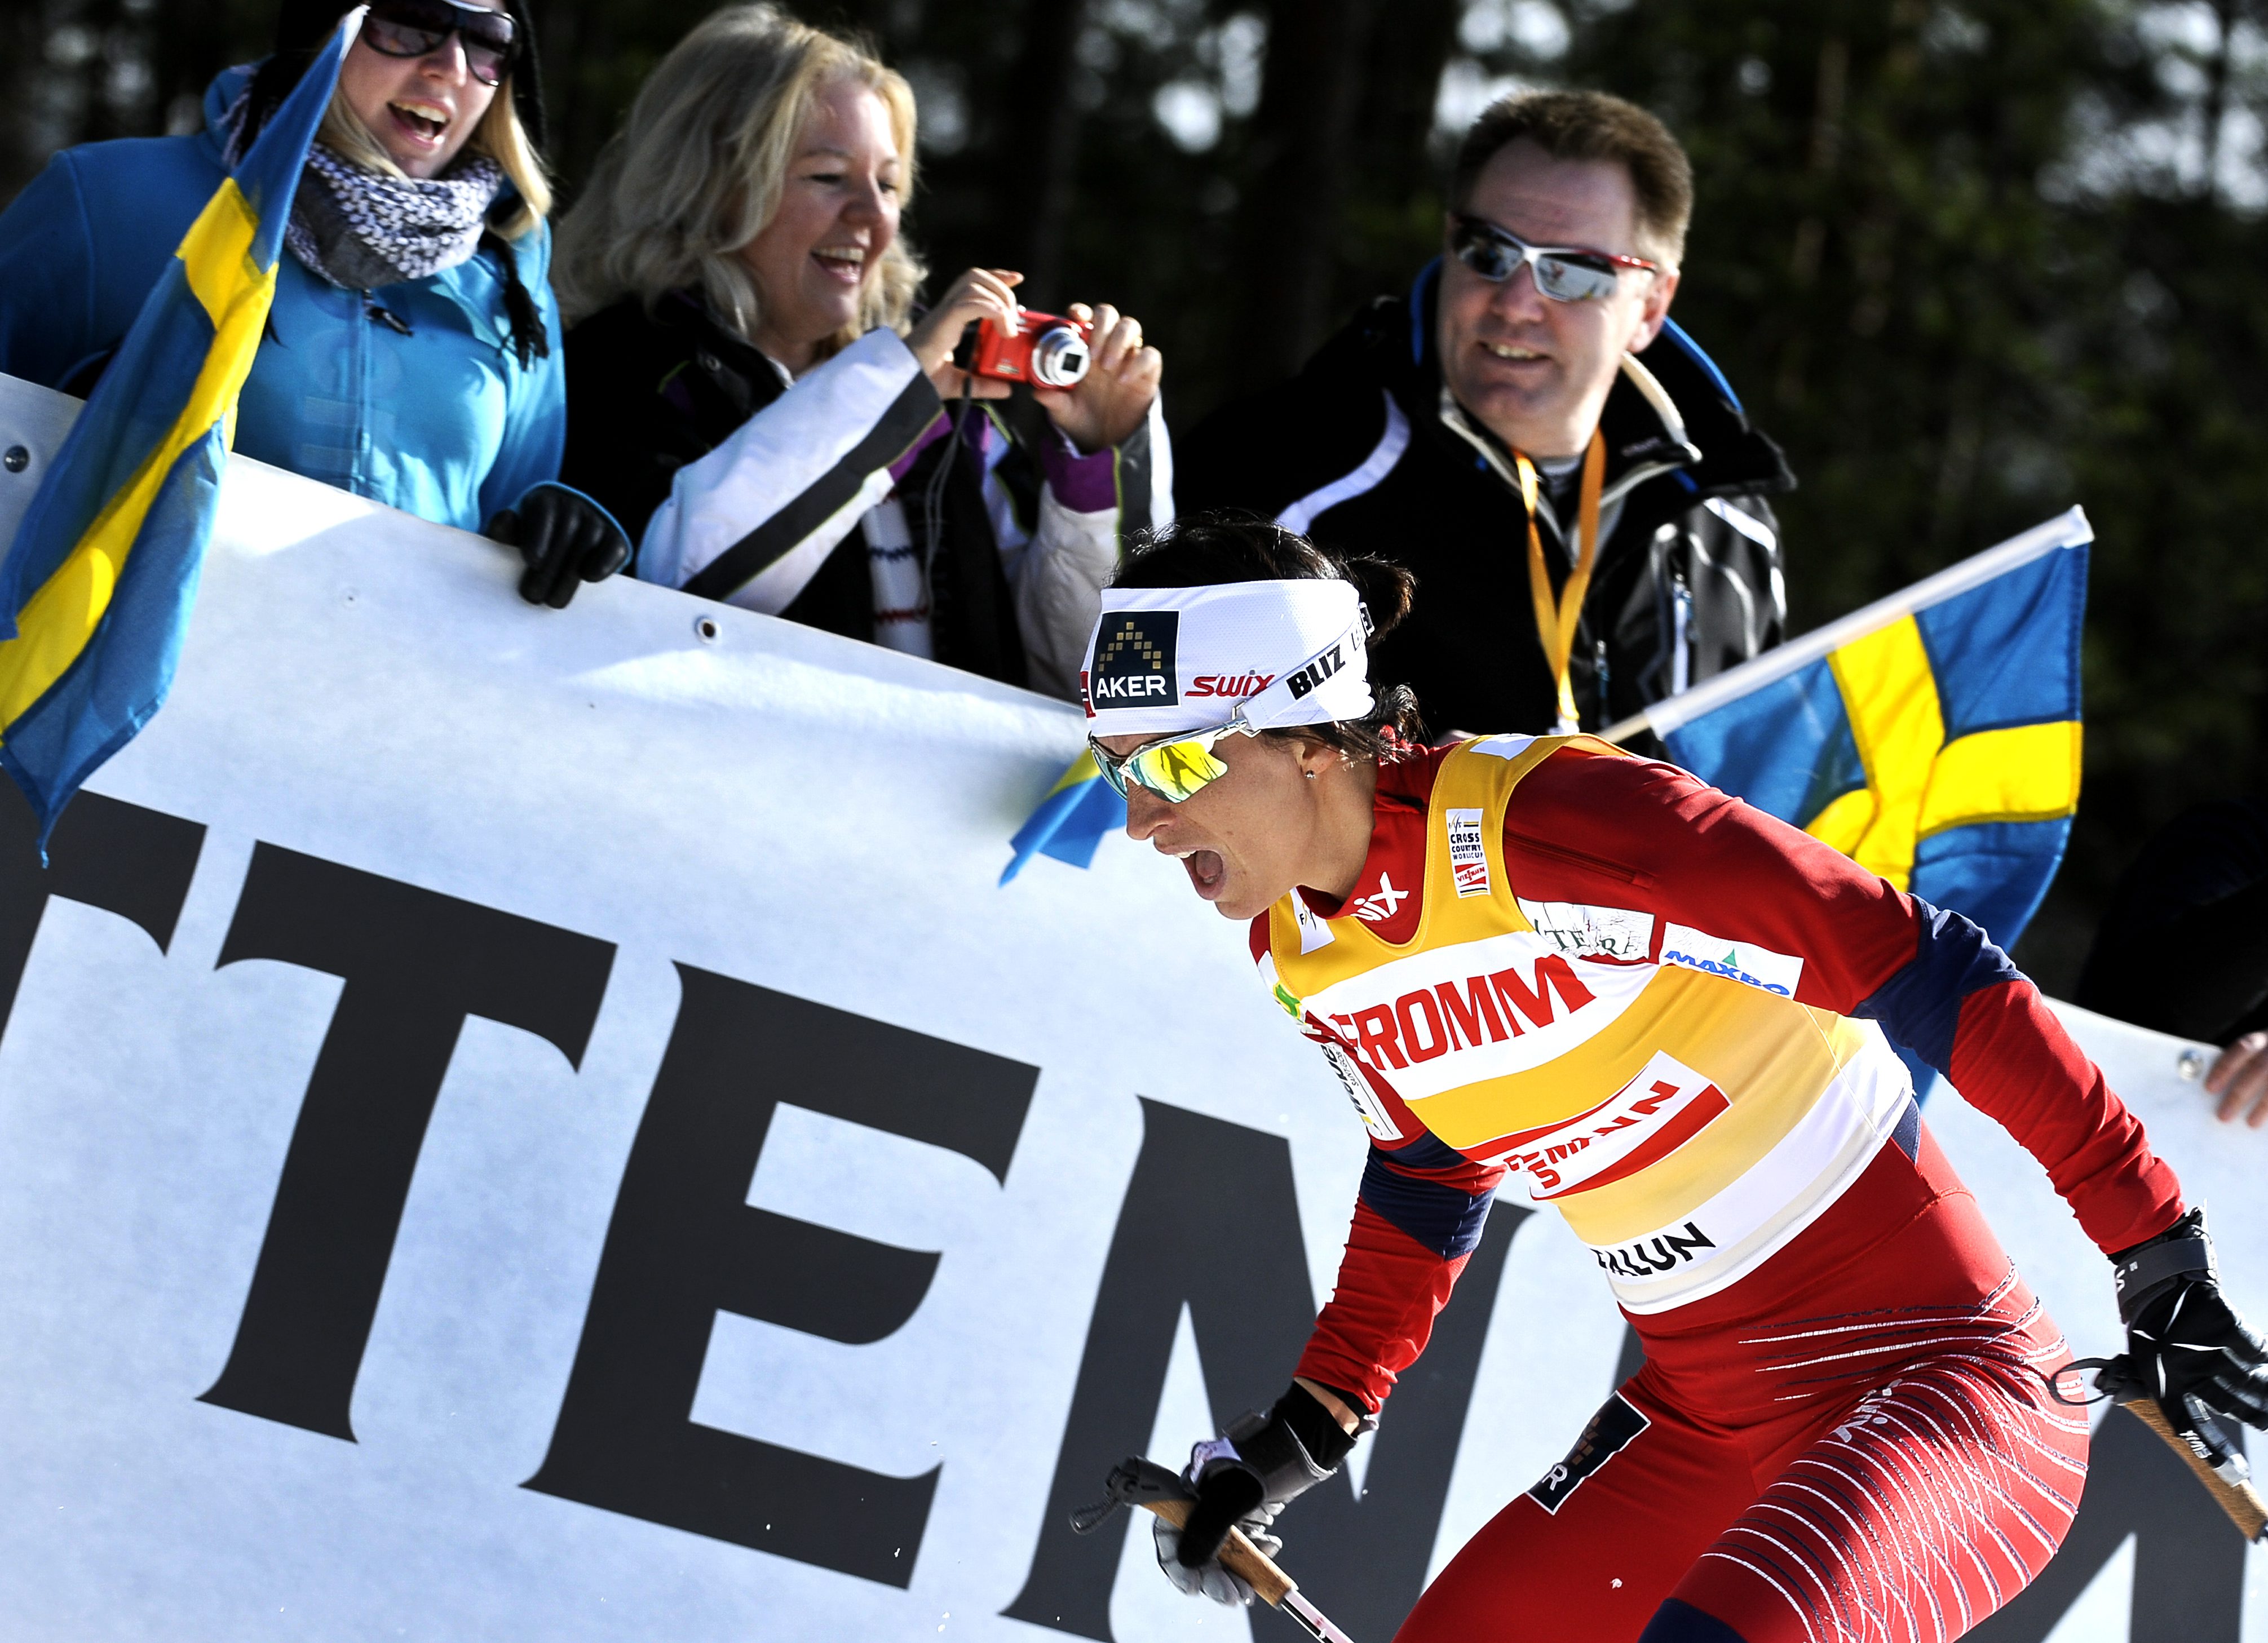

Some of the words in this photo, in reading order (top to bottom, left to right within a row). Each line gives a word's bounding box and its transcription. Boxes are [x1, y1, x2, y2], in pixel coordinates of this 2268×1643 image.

[1096, 675, 1167, 698] AKER
[1286, 644, 1346, 700] BLIZ
[1451, 832, 1480, 844] CROSS
[1664, 950, 1790, 996] MAXBO
